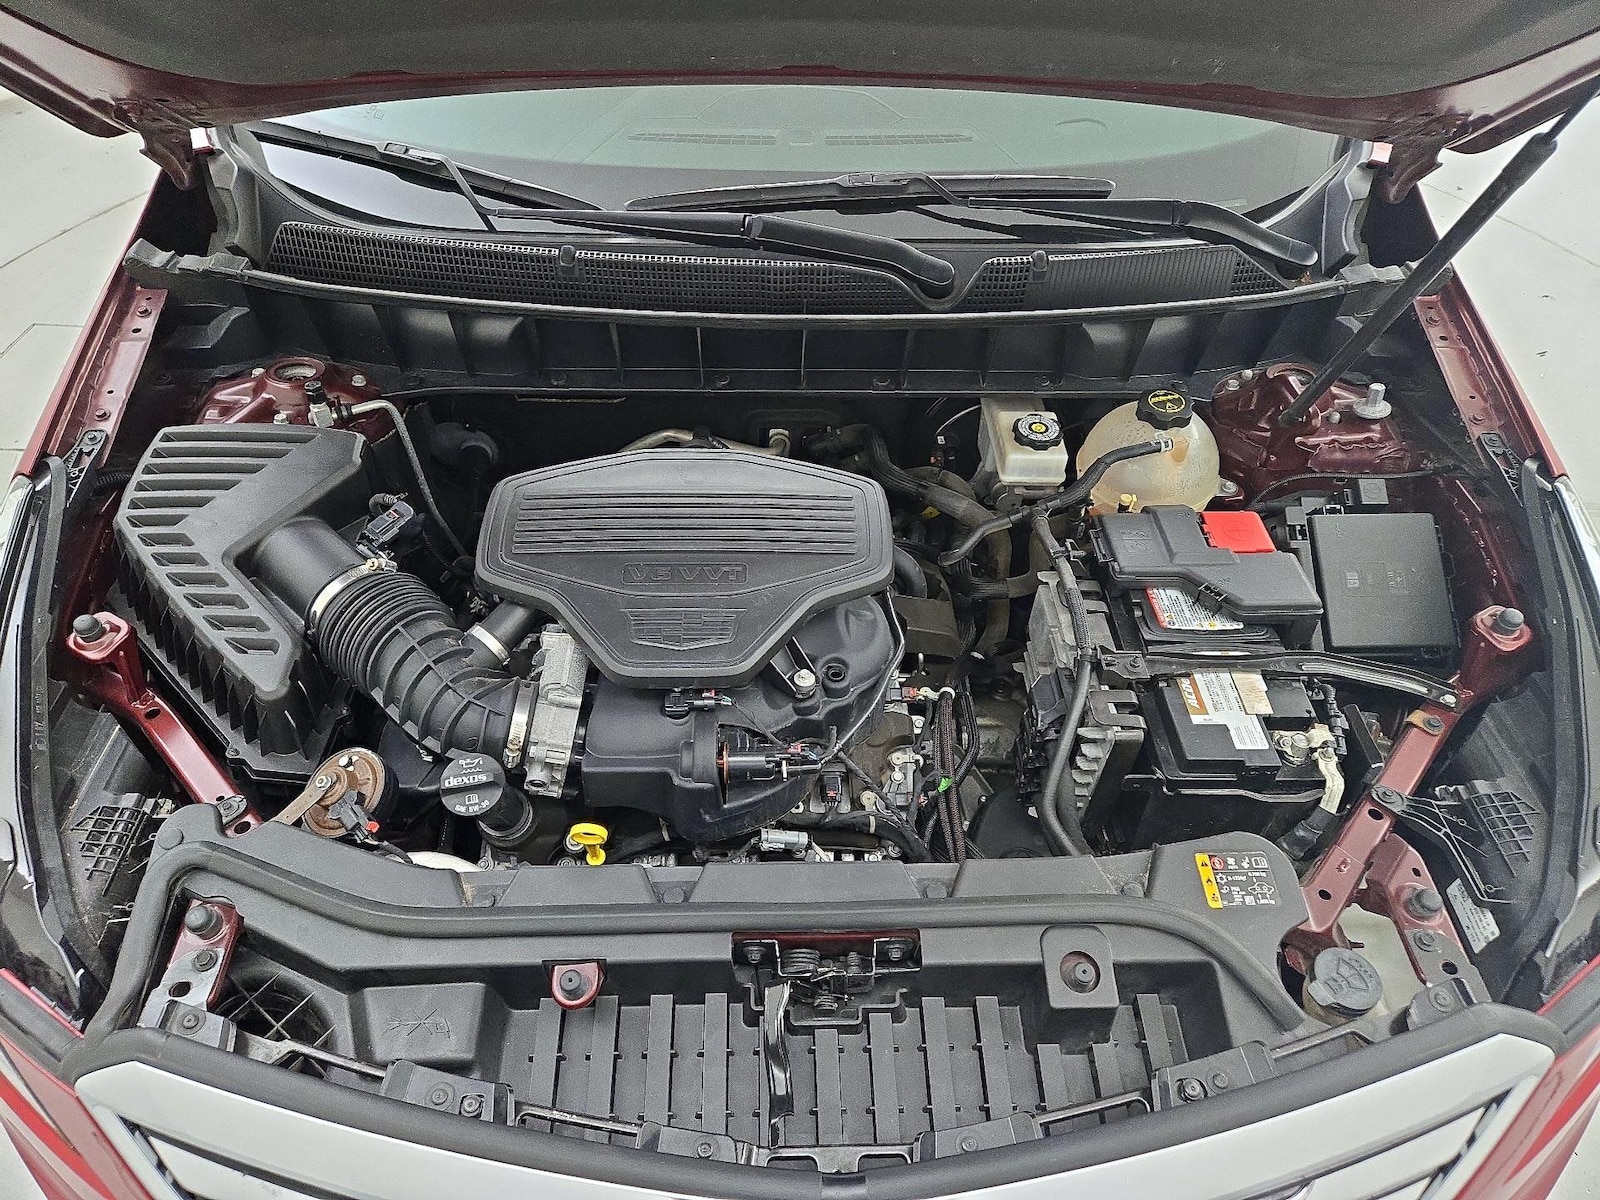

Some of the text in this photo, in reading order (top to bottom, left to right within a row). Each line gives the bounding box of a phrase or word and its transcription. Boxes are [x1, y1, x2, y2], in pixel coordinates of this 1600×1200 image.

[679, 566, 743, 580] VVT
[1180, 677, 1201, 711] ACDe
[444, 773, 487, 788] dexos
[455, 804, 467, 813] SAE
